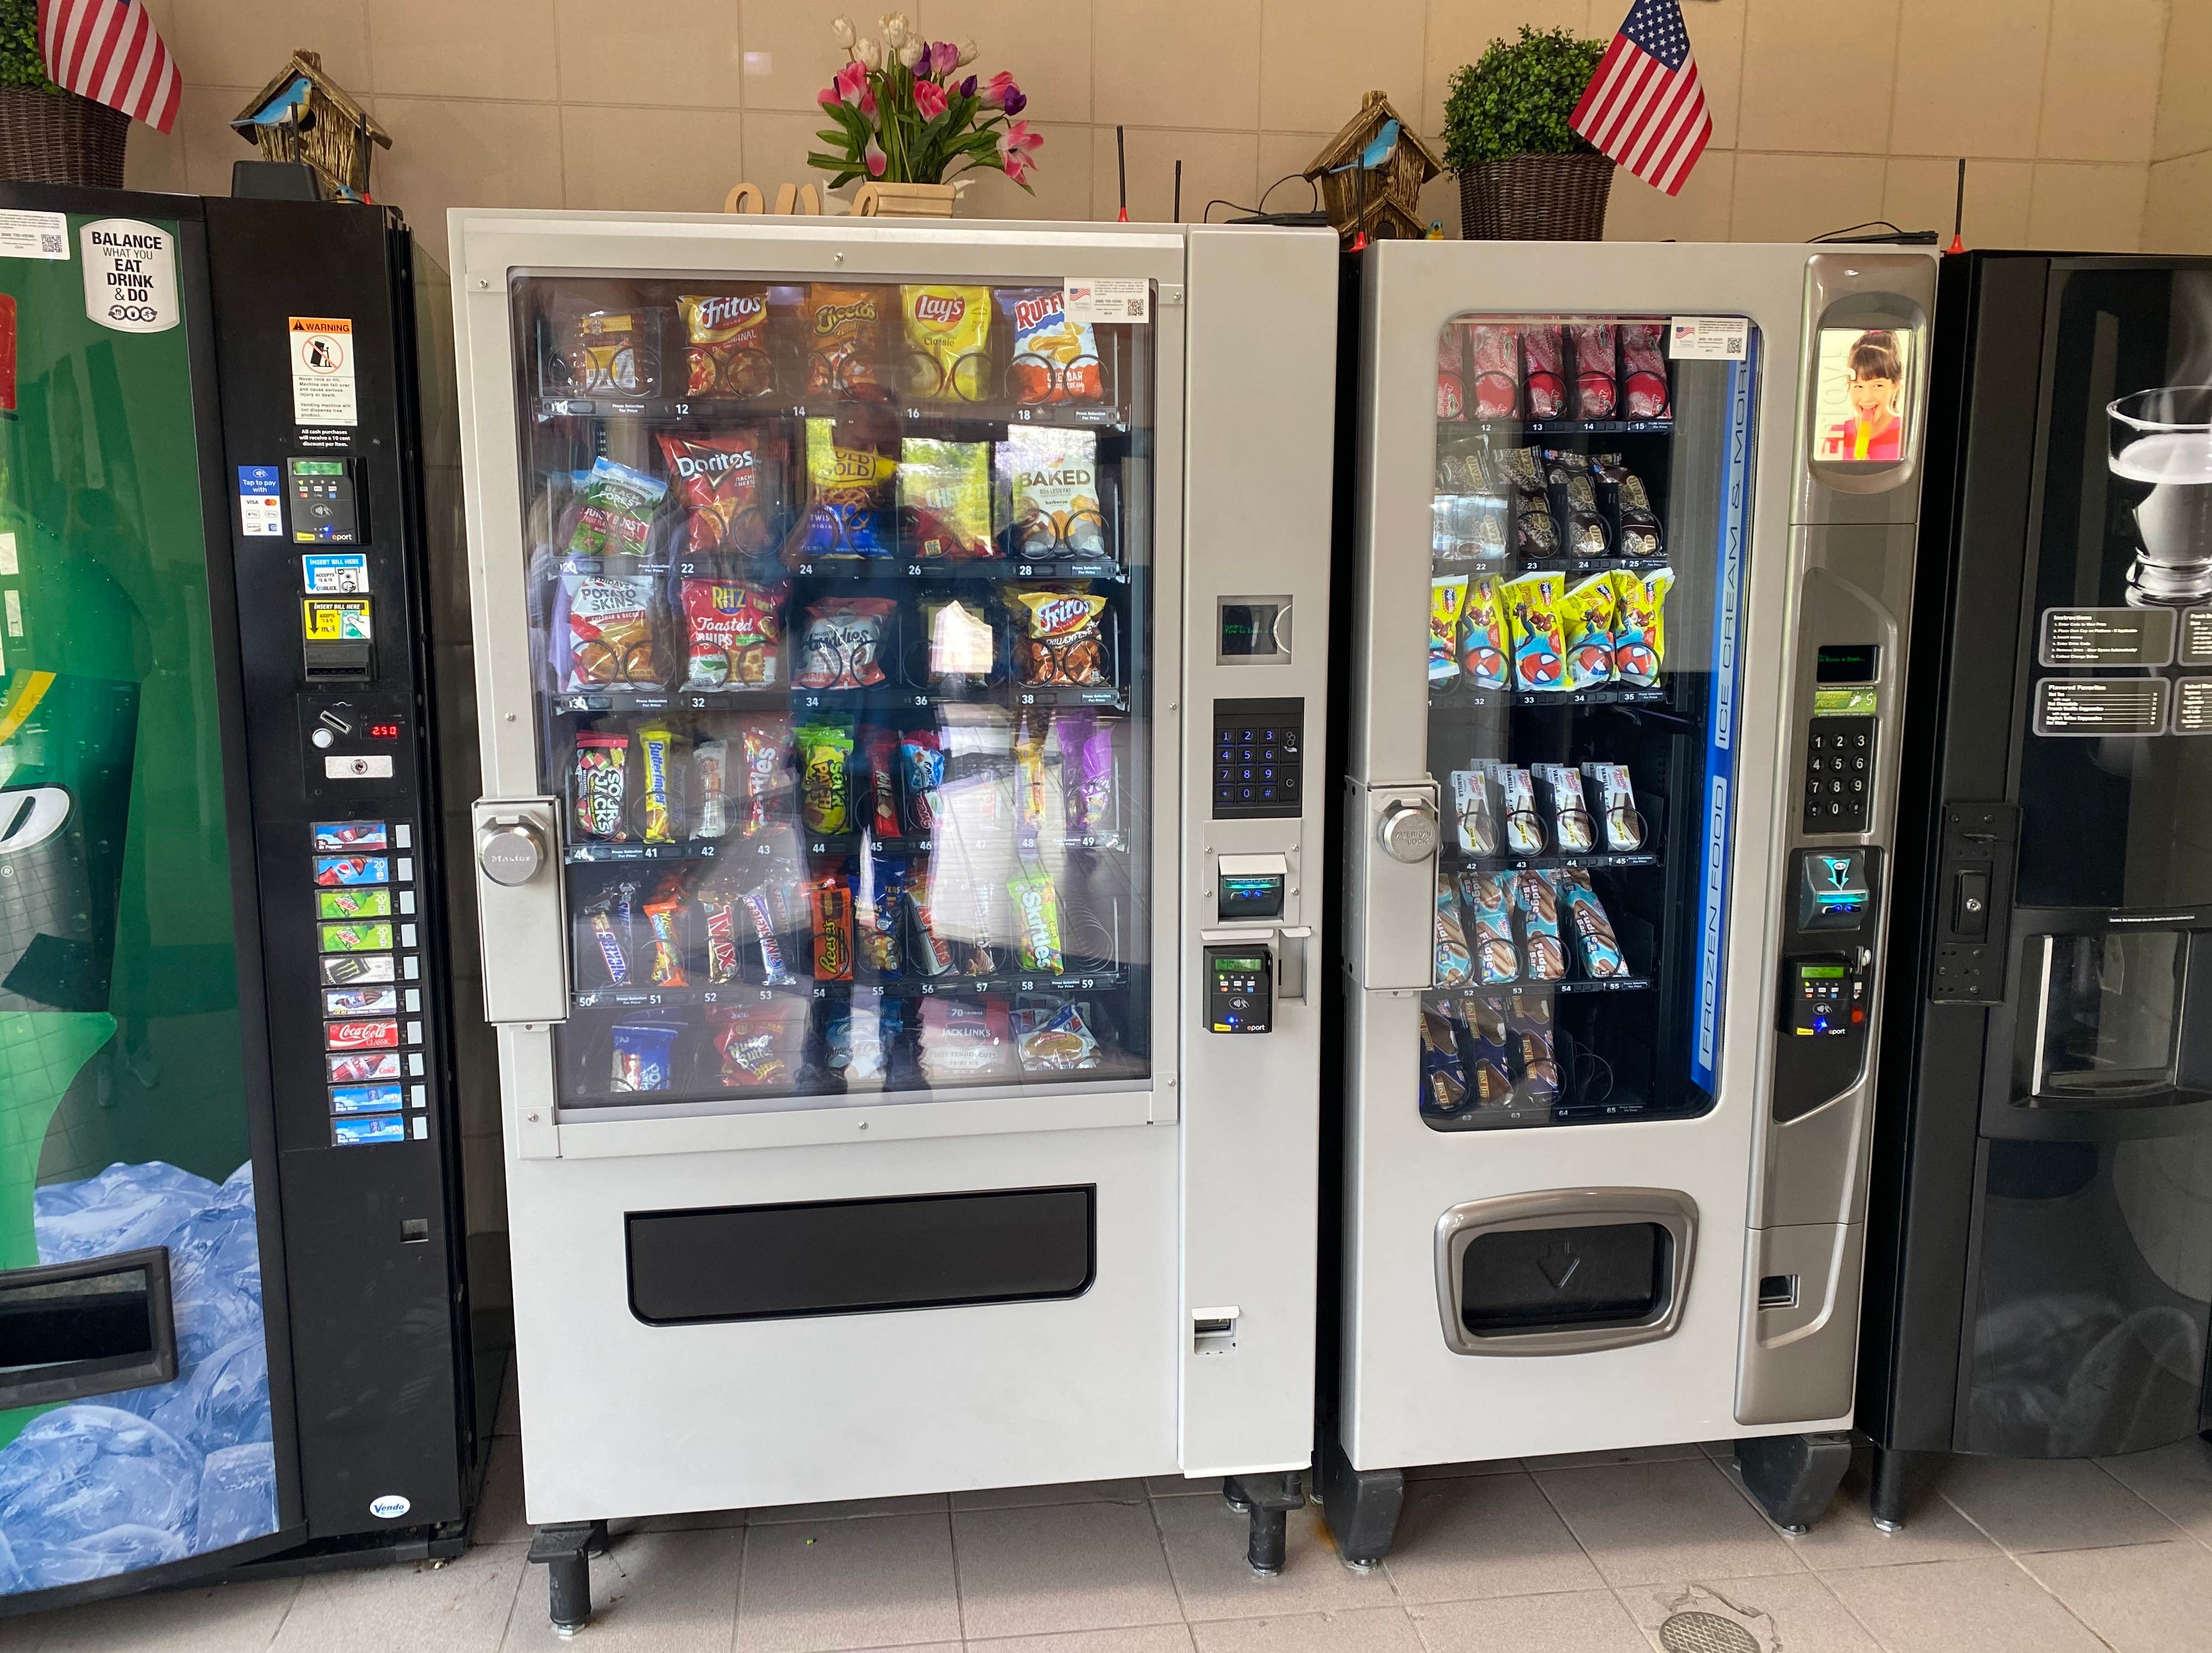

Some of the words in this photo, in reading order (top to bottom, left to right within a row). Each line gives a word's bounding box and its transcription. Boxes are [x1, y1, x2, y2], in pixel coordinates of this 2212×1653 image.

[92, 231, 162, 250] BALANCE
[103, 247, 131, 258] WHAT
[134, 250, 153, 260] YOU
[107, 272, 154, 288] DRINK
[115, 288, 125, 301] &
[128, 289, 148, 302] DO
[699, 296, 762, 329] Fritos
[918, 296, 963, 323] Lay's
[815, 301, 877, 335] Cheetos
[306, 323, 349, 332] WARNING
[924, 337, 955, 347] Classic
[676, 404, 689, 414] 12
[793, 406, 806, 416] 14
[907, 408, 920, 418] 16
[1018, 410, 1031, 420] 18
[678, 450, 753, 477] Doritos
[1019, 470, 1090, 487] BAKED
[599, 491, 641, 507] FOREST
[604, 485, 640, 503] BLACK
[1732, 480, 1741, 509] &
[681, 564, 694, 574] 22
[800, 564, 813, 574] 24
[909, 565, 921, 576] 26
[1019, 566, 1032, 575] 28
[582, 588, 637, 599] POTATO
[712, 586, 746, 609] RITZ
[1723, 526, 1738, 669] CREAM
[591, 599, 636, 611] SKINS
[591, 613, 615, 622] CHEDDAR
[1038, 599, 1090, 632] Fritos
[697, 617, 753, 632] Toasted
[696, 633, 733, 646] CHIPS
[692, 698, 705, 708] 32
[806, 697, 819, 706] 34
[916, 696, 927, 706] 36
[1022, 695, 1034, 704] 38
[1718, 685, 1729, 741] ICE
[1245, 731, 1251, 740] 2
[1266, 731, 1272, 740] 3
[1816, 737, 1821, 748] 1
[1836, 736, 1843, 747] 2
[1858, 735, 1865, 746] 3
[1222, 751, 1229, 760] 4
[1244, 750, 1250, 759] 5
[1266, 750, 1272, 759] 6
[1813, 759, 1820, 770] 4
[1835, 758, 1842, 770] 5
[1856, 757, 1864, 769] 6
[648, 742, 666, 804] Butterfinger
[1222, 770, 1229, 779] 7
[1244, 770, 1250, 779] 8
[1265, 770, 1271, 778] 9
[1286, 779, 1293, 787] C
[1505, 770, 1514, 794] VANILLA
[1812, 781, 1819, 793] 7
[1833, 781, 1840, 792] 8
[1854, 780, 1862, 791] 9
[607, 769, 621, 821] SOUR
[1244, 789, 1250, 797] 0
[594, 775, 610, 832] JACKS
[1832, 803, 1839, 814] 0
[870, 842, 882, 851] 45
[920, 842, 932, 850] 46
[1022, 839, 1034, 847] 48
[1082, 837, 1094, 846] 49
[645, 848, 657, 857] 41
[701, 847, 714, 856] 42
[758, 845, 770, 854] 43
[812, 844, 825, 853] 44
[1528, 878, 1540, 913] Fudge
[1703, 906, 1718, 1055] FROZEN
[1711, 785, 1724, 891] FOOD
[1022, 892, 1052, 968] Skittles
[1576, 918, 1586, 937] Bar
[1579, 909, 1598, 944] Fudge
[707, 905, 736, 970] TWIX
[819, 920, 837, 973] Reese's
[597, 933, 626, 983] SNICKERS
[976, 983, 988, 992] 57
[1022, 981, 1033, 990] 58
[1082, 980, 1094, 988] 59
[814, 989, 825, 998] 54
[872, 987, 884, 995] 55
[922, 985, 933, 994] 56
[650, 995, 661, 1004] 51
[704, 993, 717, 1001] 52
[760, 991, 772, 999] 53
[579, 998, 591, 1006] 50
[951, 1009, 963, 1017] 70
[339, 1023, 386, 1039] Coca-Cola
[941, 1029, 963, 1037] JACK
[965, 1029, 991, 1037] LINK'S
[373, 1503, 404, 1513] Vendo
